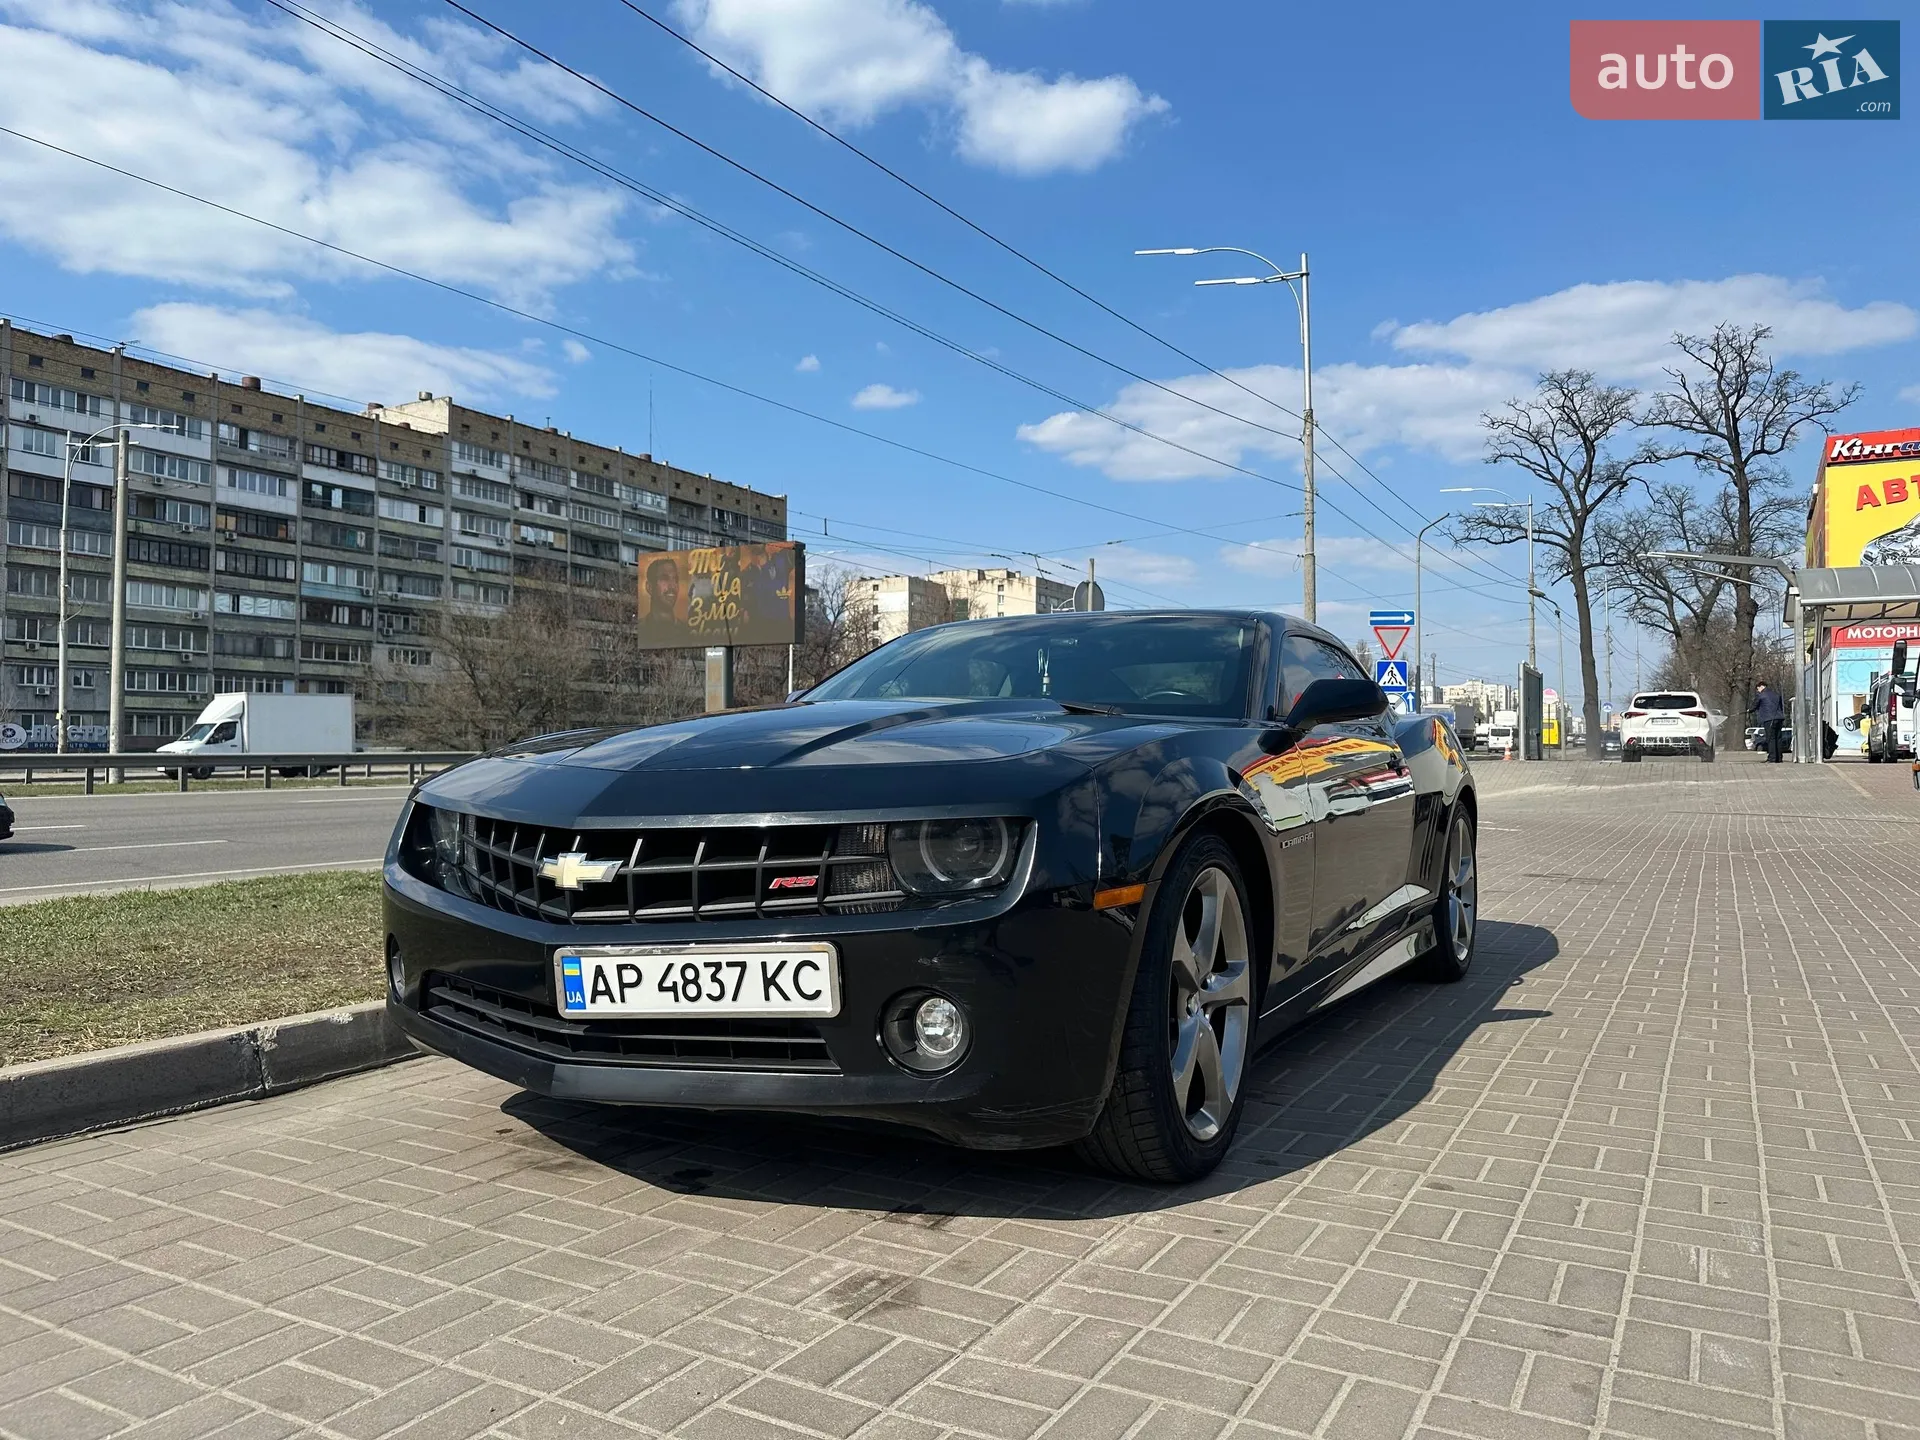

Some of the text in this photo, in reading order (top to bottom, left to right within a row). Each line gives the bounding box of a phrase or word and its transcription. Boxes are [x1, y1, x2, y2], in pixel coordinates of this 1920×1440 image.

[1847, 626, 1920, 639] МОТОРН
[33, 725, 111, 741] ЛЮСТР
[1282, 831, 1314, 849] CAMARO
[768, 875, 819, 889] RS
[590, 959, 822, 1004] AP 4837 KC
[566, 991, 584, 1004] UA
